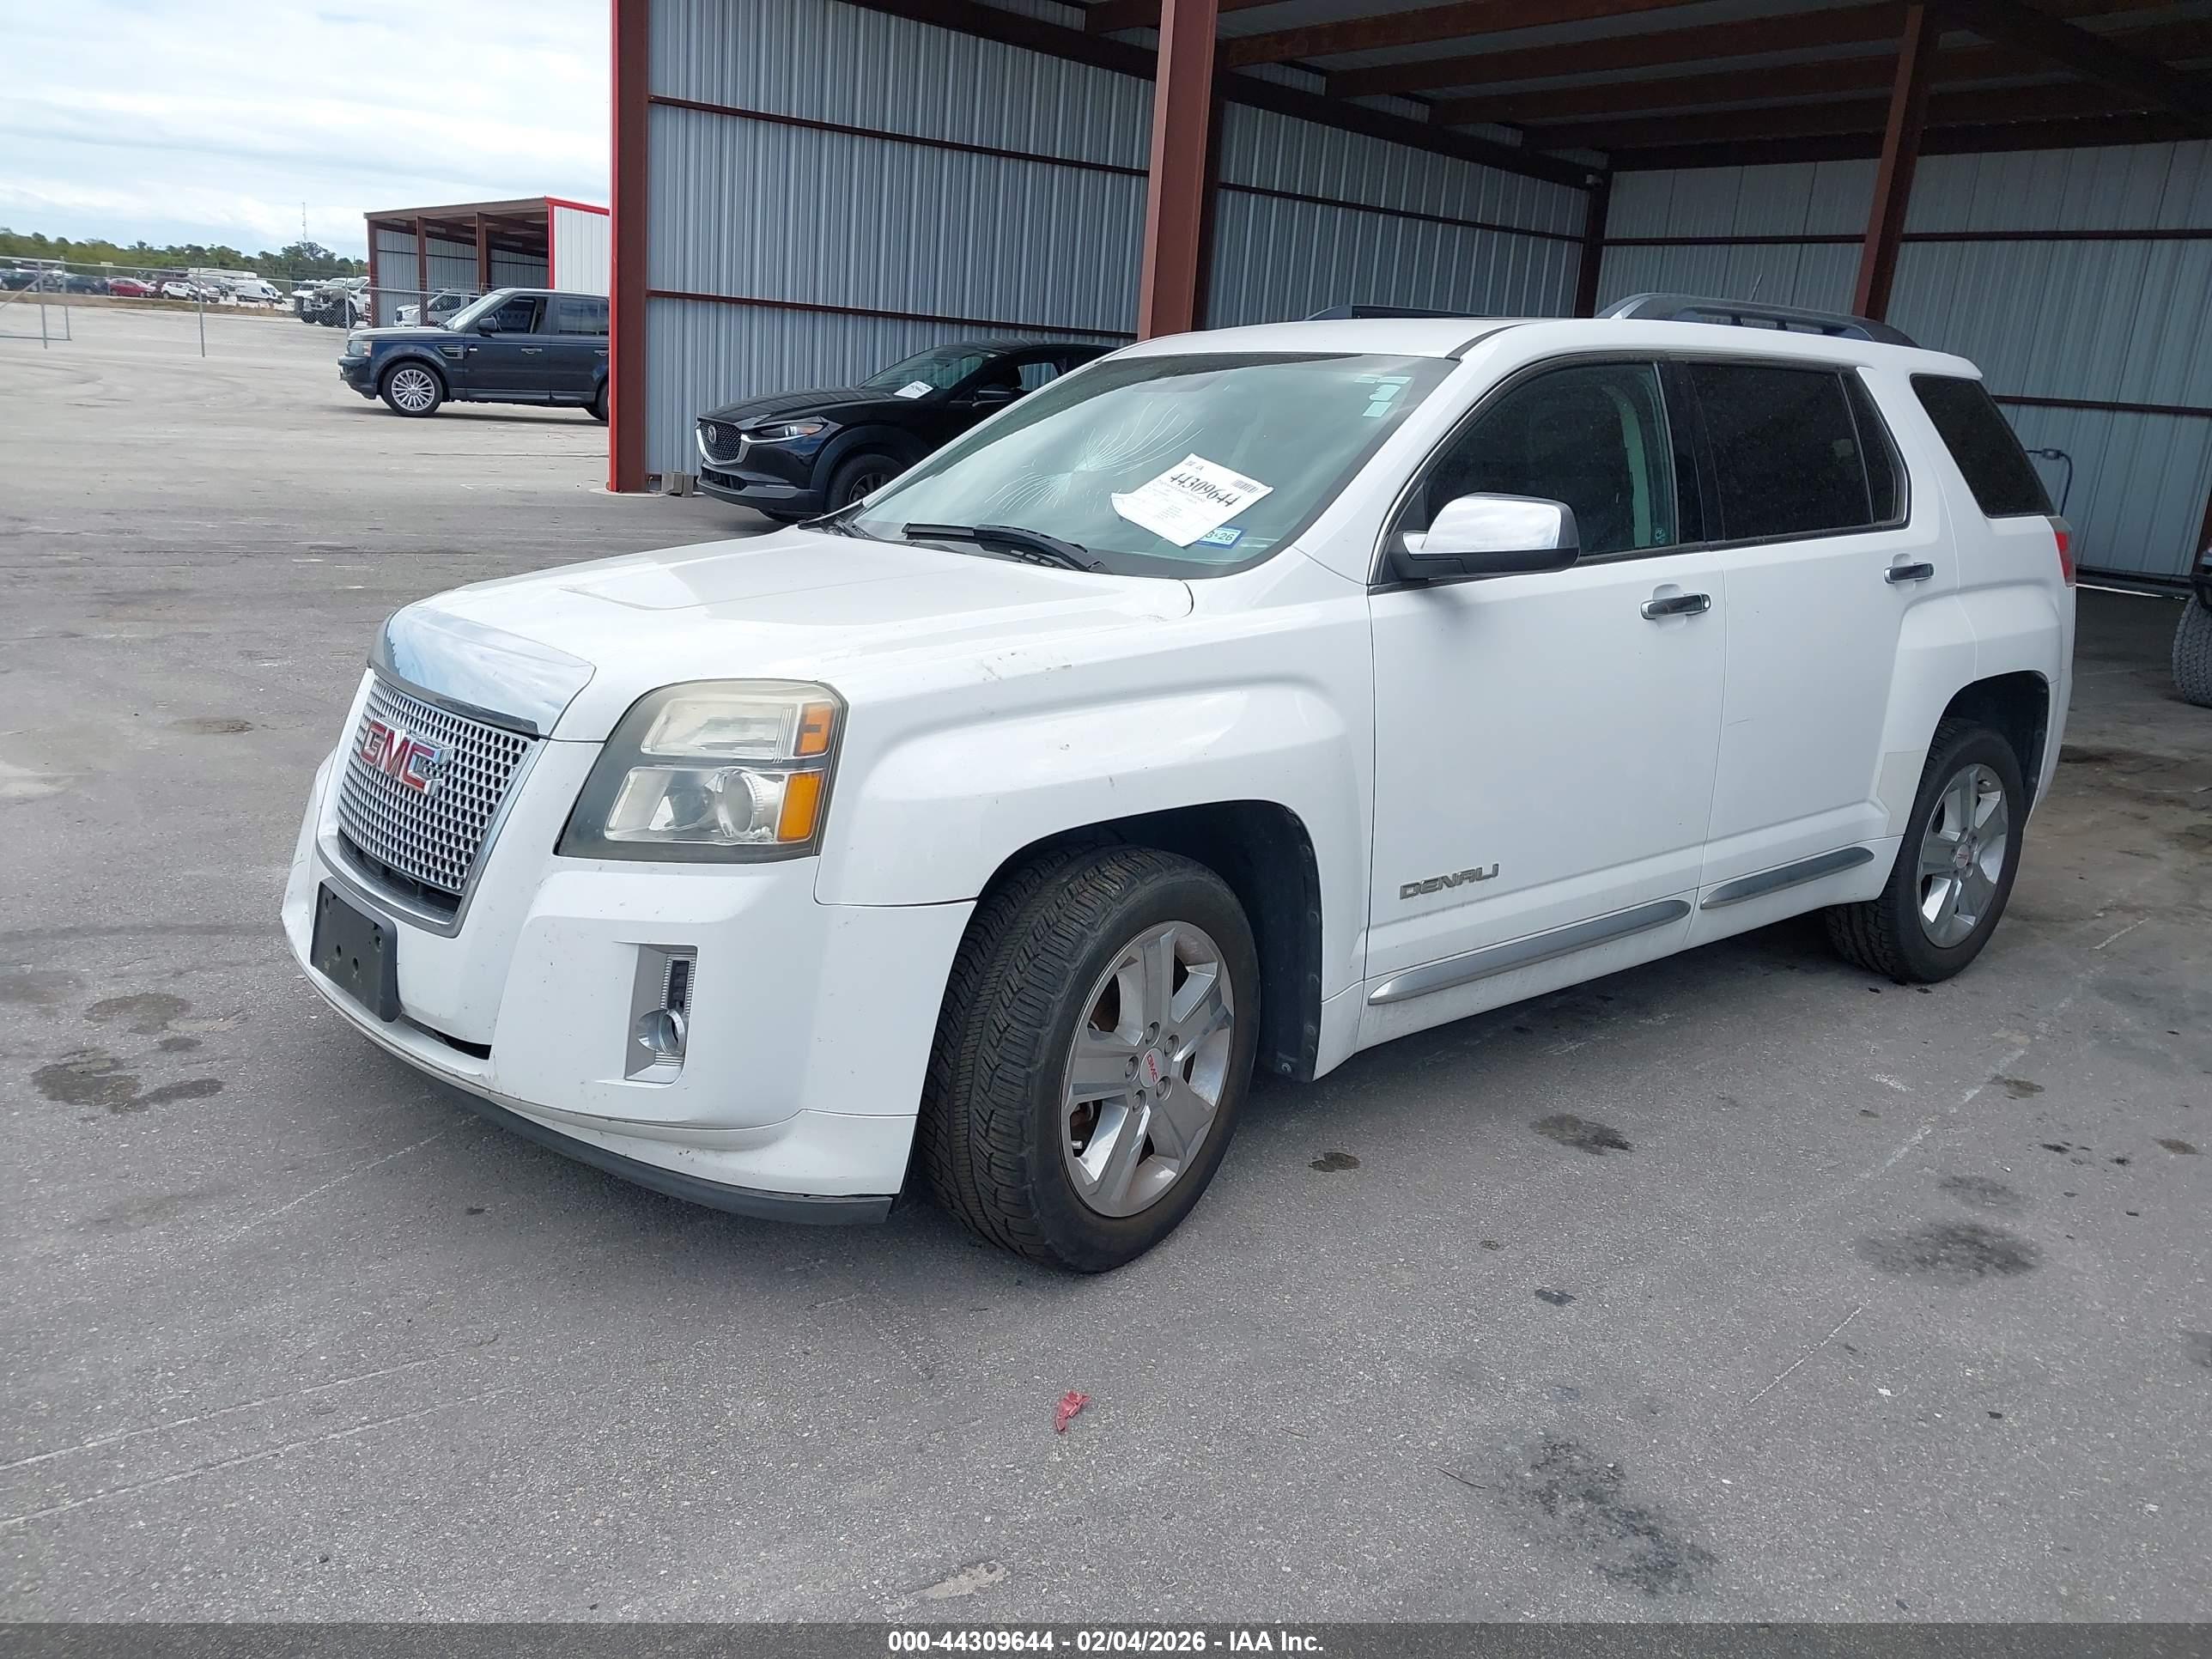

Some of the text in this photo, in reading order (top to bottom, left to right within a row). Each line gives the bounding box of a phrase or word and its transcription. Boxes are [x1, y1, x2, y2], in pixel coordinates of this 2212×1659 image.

[1170, 471, 1242, 507] 44309644
[361, 718, 452, 797] GMC
[1399, 862, 1499, 900] DENALI
[1146, 1053, 1158, 1083] GMC
